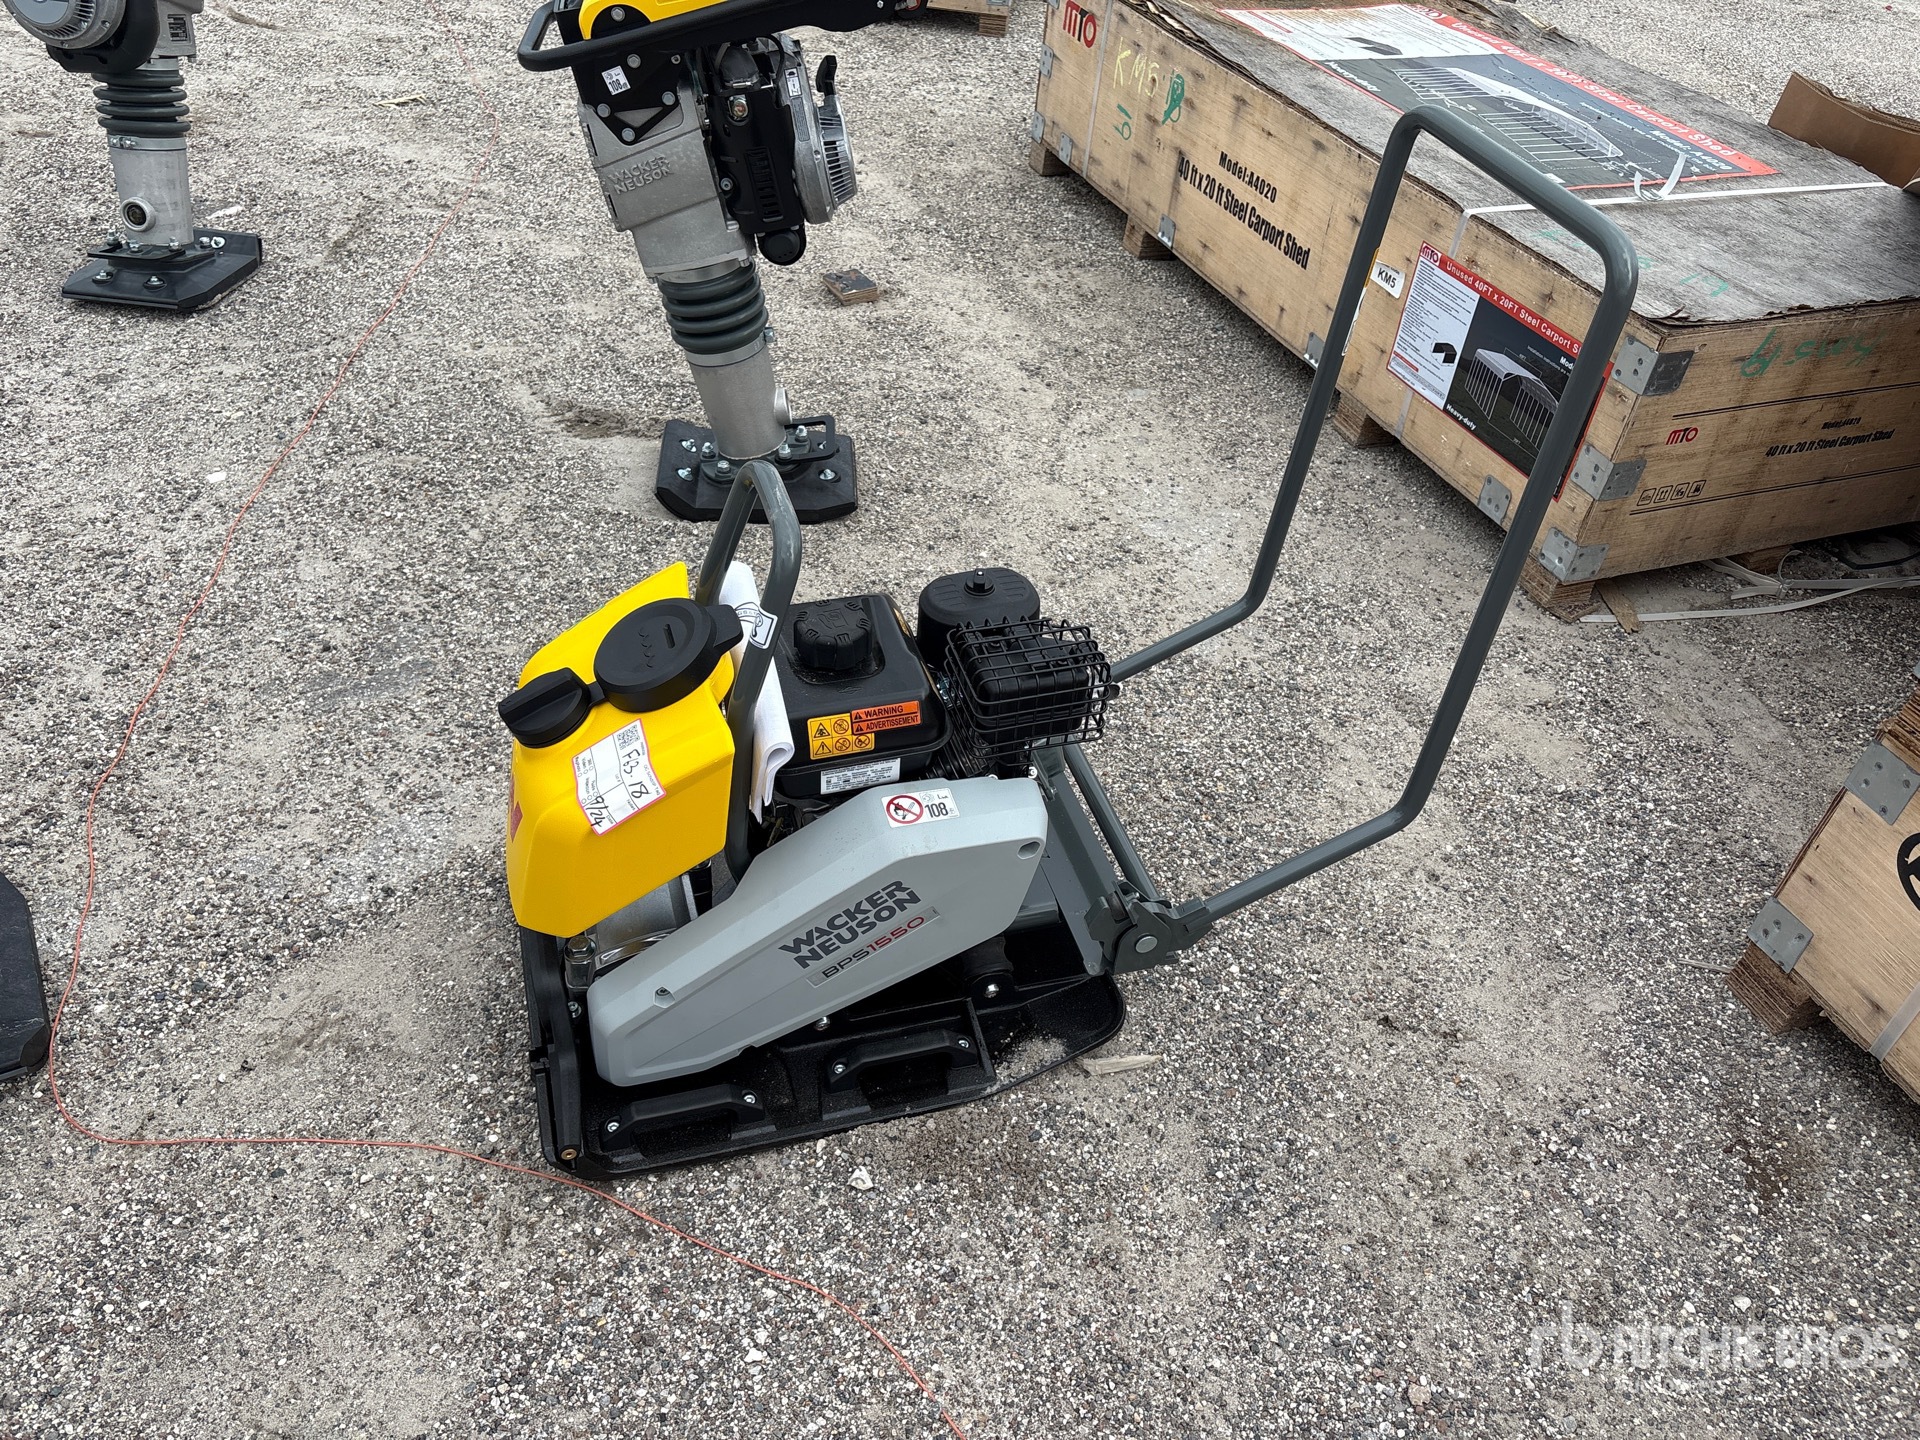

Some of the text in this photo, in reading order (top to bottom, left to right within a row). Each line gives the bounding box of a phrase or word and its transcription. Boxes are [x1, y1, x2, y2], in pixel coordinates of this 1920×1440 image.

[608, 79, 623, 93] 108
[1625, 103, 1690, 133] Carport
[1687, 133, 1738, 156] Shed
[608, 154, 671, 183] WACKER
[614, 165, 671, 194] NEUSON
[1218, 151, 1278, 203] Model:A4020
[1178, 156, 1311, 270] 40 ft x 20 ft Steel Carport Shed
[1377, 267, 1397, 289] KM5
[1446, 261, 1474, 284] Unused
[1474, 280, 1493, 296] 40FT
[1493, 293, 1500, 301] x
[1500, 296, 1519, 313] 20FT
[1519, 309, 1540, 328] Steel
[1541, 323, 1571, 349] Carport
[1446, 403, 1477, 431] Heavy-duty
[1765, 445, 1780, 457] 40
[1794, 442, 1807, 453] 20
[1814, 438, 1840, 451] Steel
[1838, 432, 1873, 447] Carport
[1872, 429, 1896, 442] Shed
[864, 705, 904, 719] WARNING
[866, 715, 919, 731] ADVERTISSEMENT
[924, 802, 949, 818] 108
[778, 880, 911, 955] WACKER
[793, 889, 922, 970] NEUSON
[821, 916, 925, 979] BPS1550
